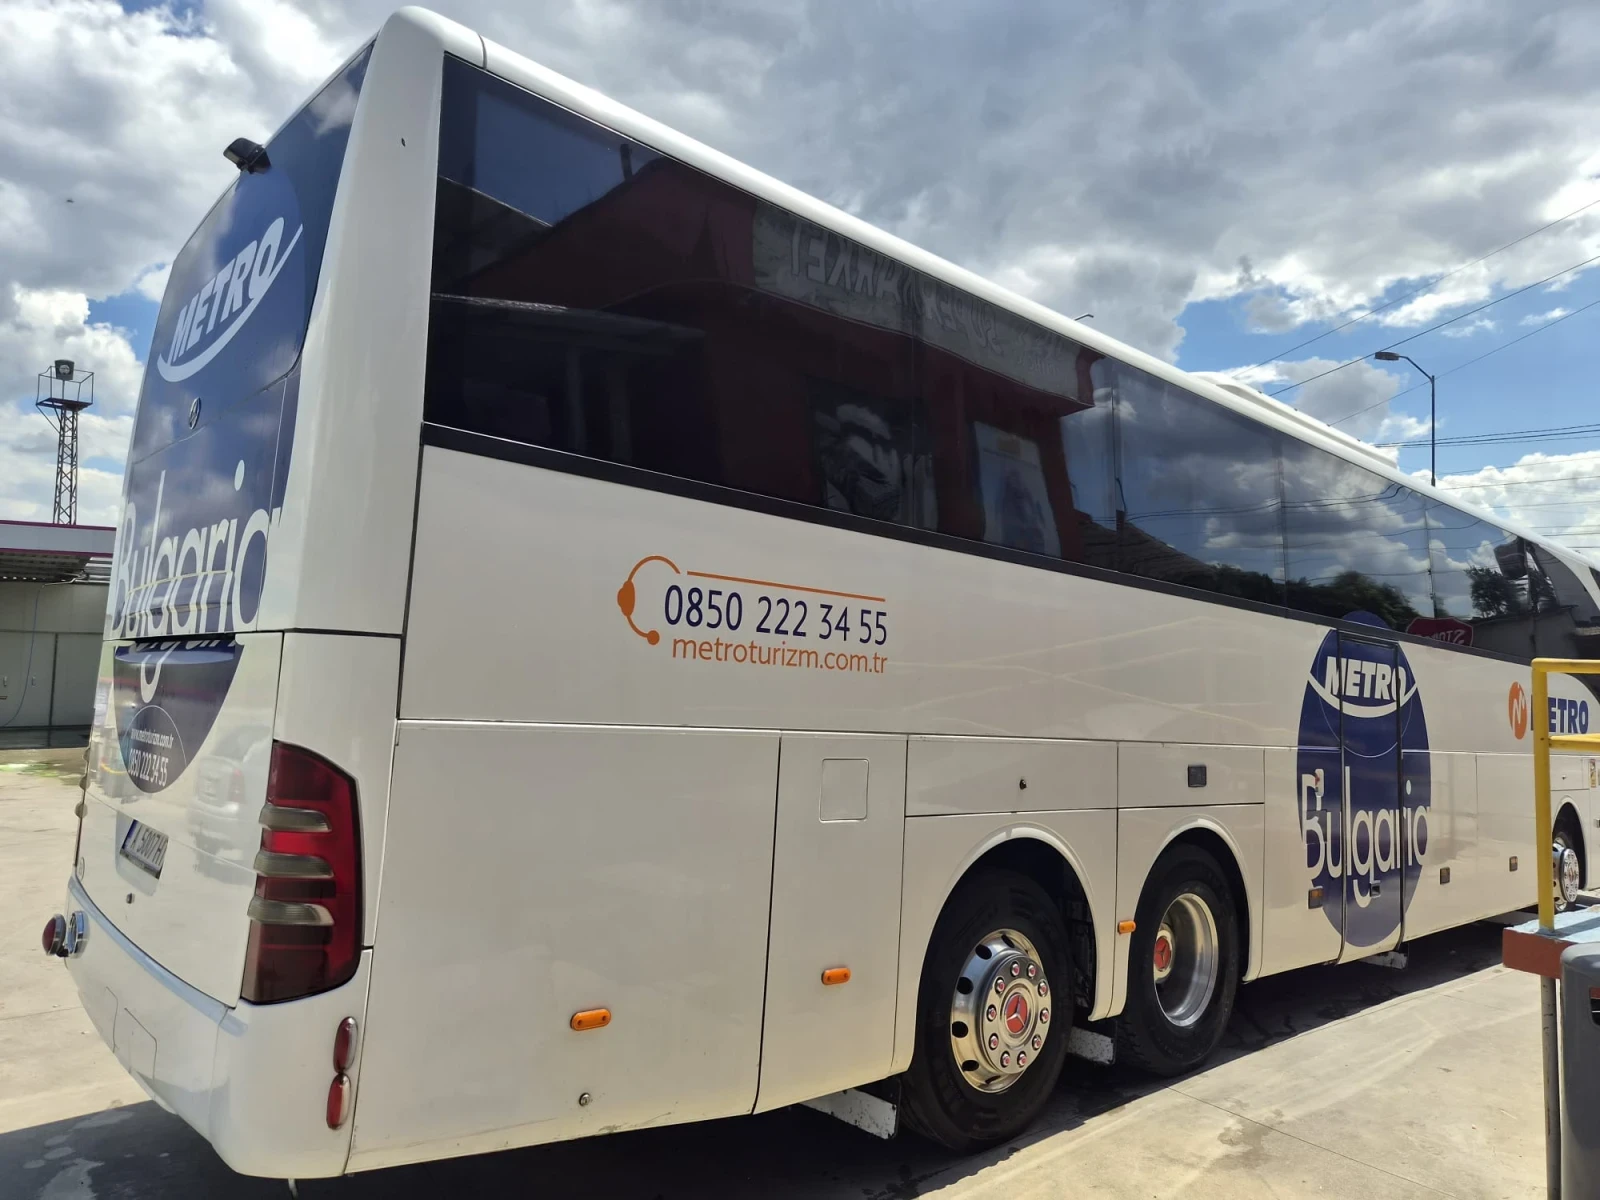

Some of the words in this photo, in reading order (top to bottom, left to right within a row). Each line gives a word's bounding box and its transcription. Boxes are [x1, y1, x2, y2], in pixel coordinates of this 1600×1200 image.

[171, 217, 285, 366] METRO
[108, 460, 282, 703] Bulgaria
[664, 584, 743, 631] 0850
[755, 596, 808, 637] 222
[818, 603, 851, 642] 34
[859, 609, 888, 646] 55
[672, 637, 888, 674] metroturizm.com.tr
[1324, 655, 1407, 701] METRO
[139, 751, 152, 782] 222
[158, 756, 169, 788] 55
[1301, 766, 1432, 909] Bulgaria
